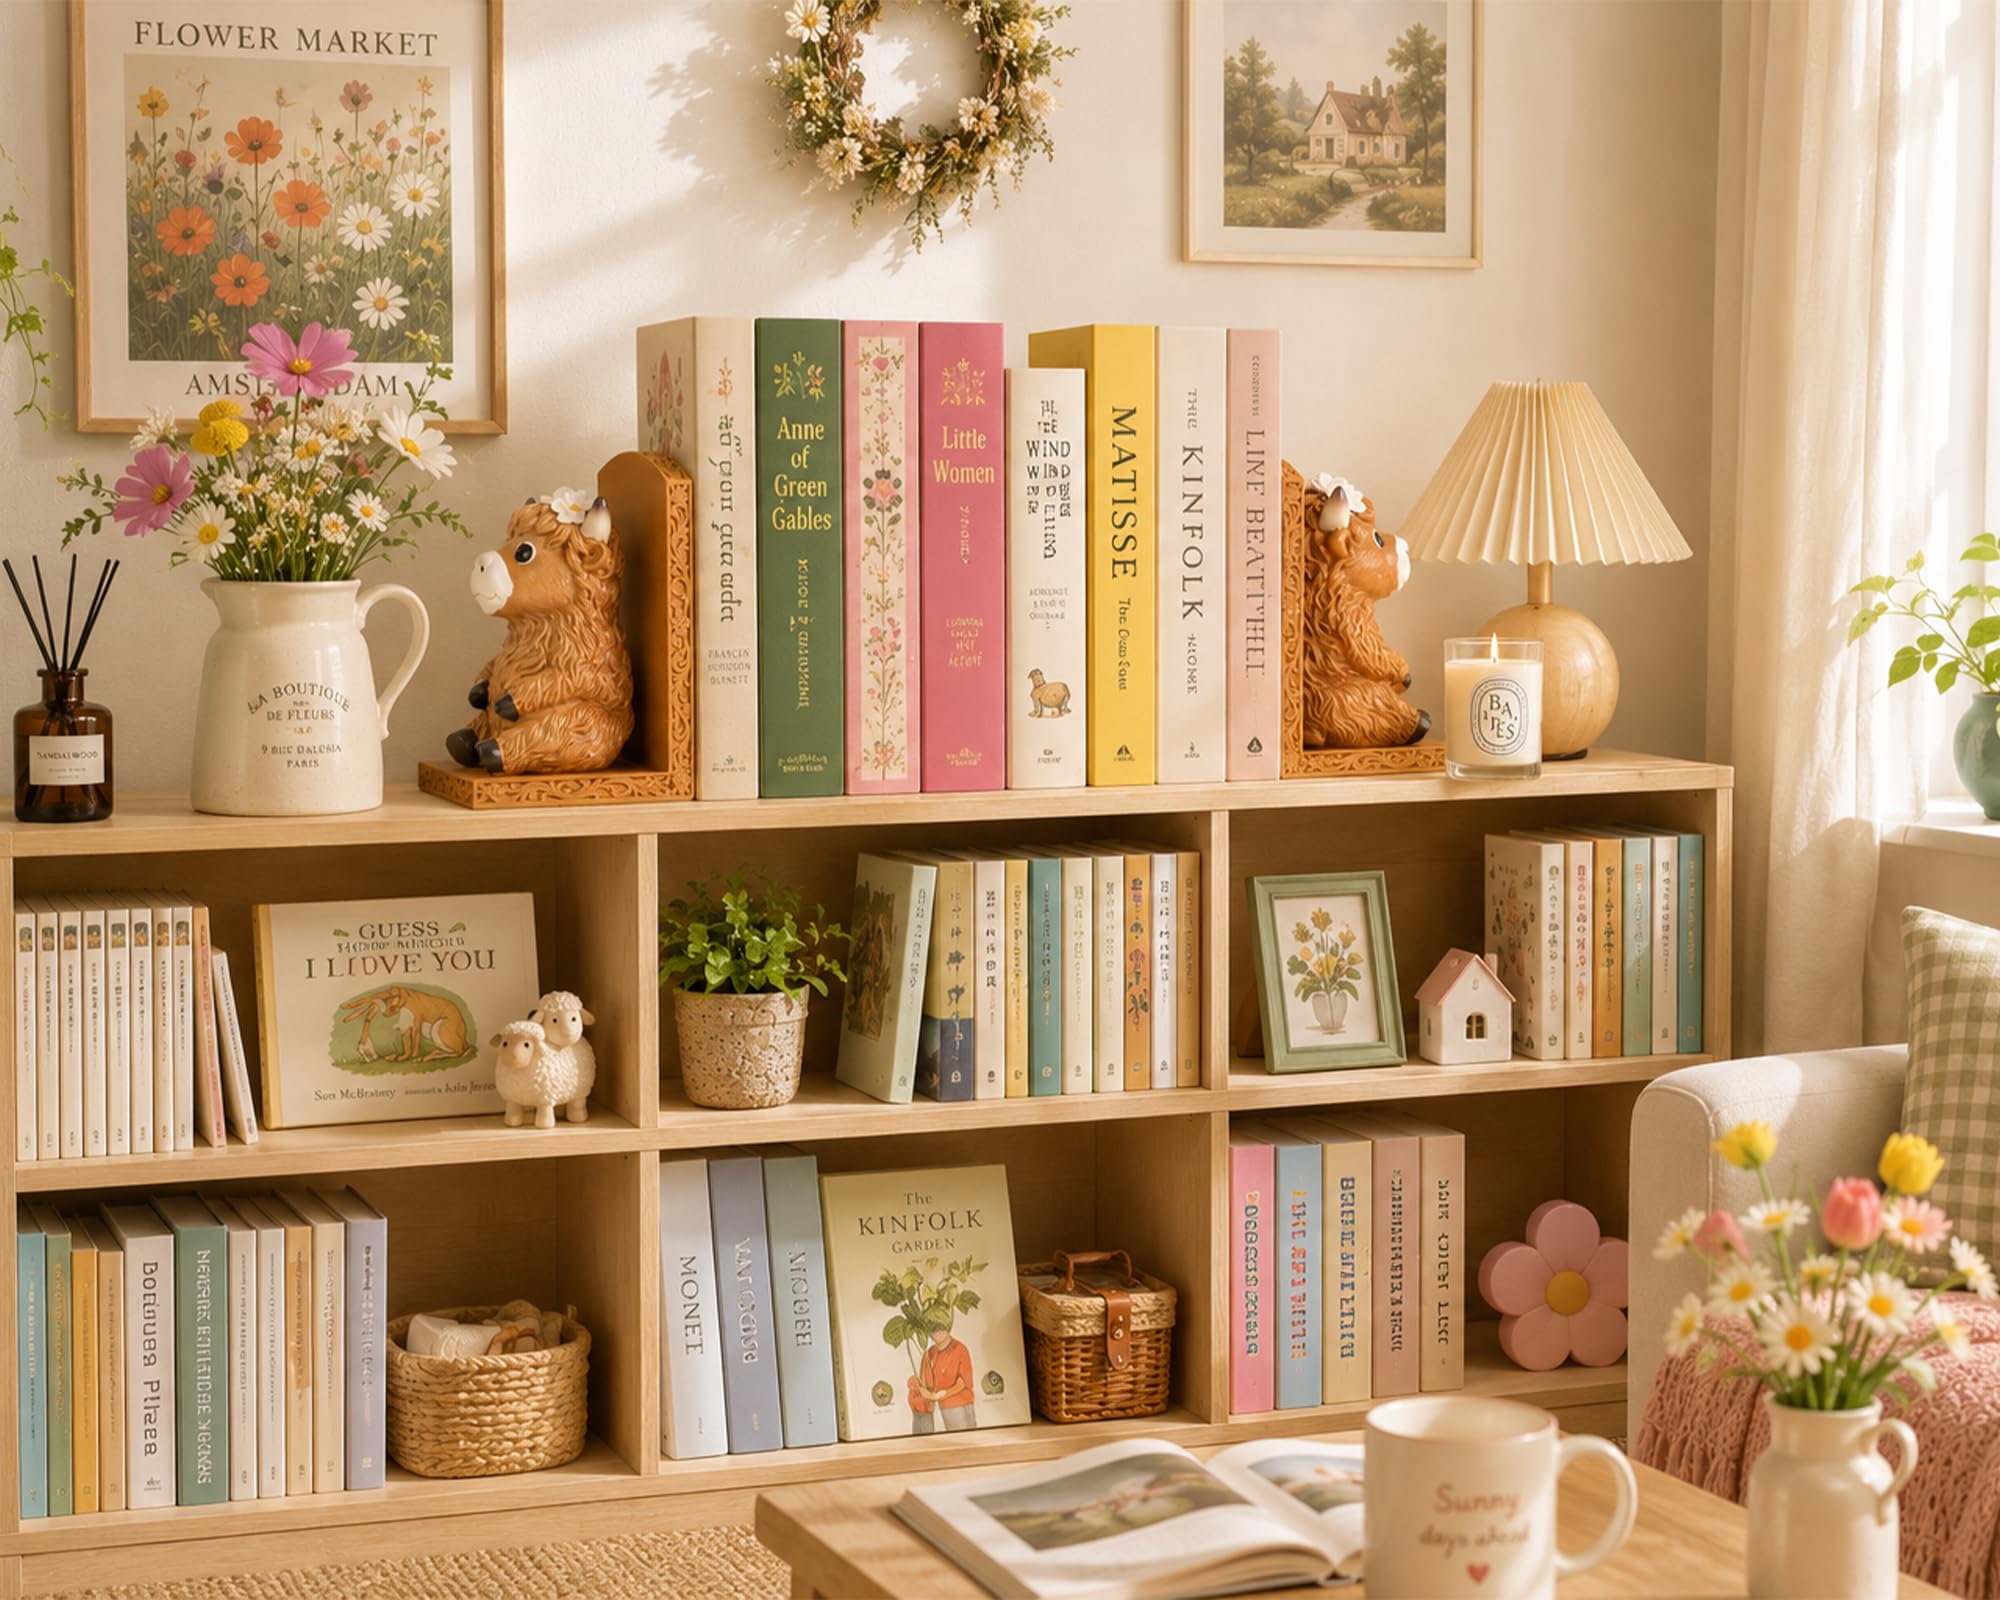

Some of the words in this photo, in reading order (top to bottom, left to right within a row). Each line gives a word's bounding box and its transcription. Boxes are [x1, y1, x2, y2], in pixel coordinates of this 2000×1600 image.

[134, 20, 279, 50] FLOWER
[296, 27, 439, 57] MARKET
[777, 416, 825, 440] Anne
[941, 425, 987, 450] Little
[790, 444, 811, 469] of
[1026, 440, 1071, 458] WIND
[932, 458, 996, 484] Women
[773, 472, 828, 498] Green
[1111, 405, 1138, 579] MATISSE
[771, 506, 833, 531] Gables
[1181, 444, 1204, 620] KINFOLK
[266, 710, 283, 721] DE
[358, 921, 440, 940] GUESS
[305, 957, 318, 980] I
[432, 948, 497, 972] YOU
[903, 1191, 934, 1206] The
[857, 1208, 984, 1236] KINFOLK
[891, 1237, 956, 1254] GARDEN
[679, 1254, 705, 1356] MONET
[1434, 1482, 1520, 1517] Sunny
